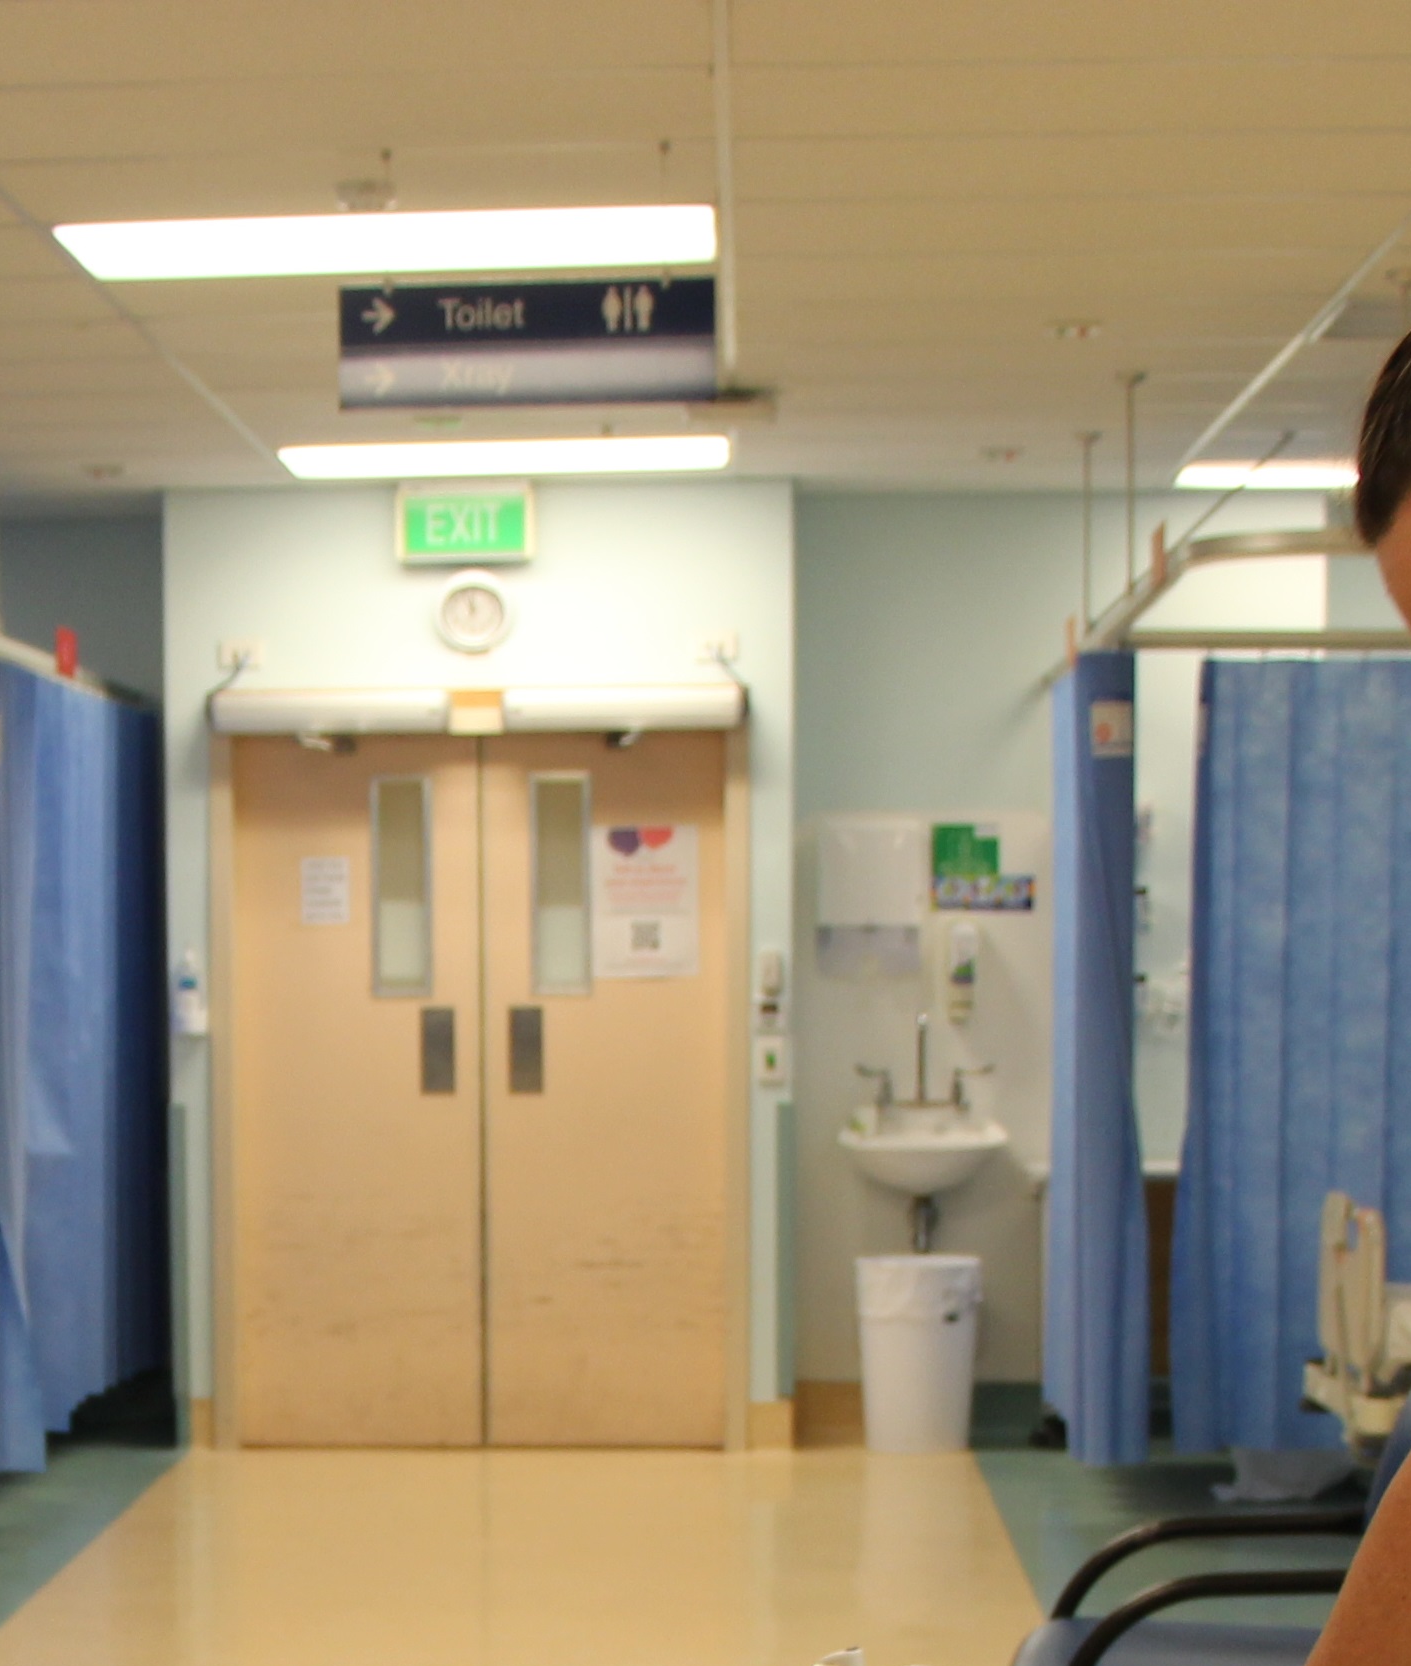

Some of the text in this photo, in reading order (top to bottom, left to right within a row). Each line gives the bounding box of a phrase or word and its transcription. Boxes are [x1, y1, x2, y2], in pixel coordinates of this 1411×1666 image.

[438, 297, 526, 331] Toilet
[441, 362, 515, 395] Xray
[424, 500, 503, 546] EXIT
